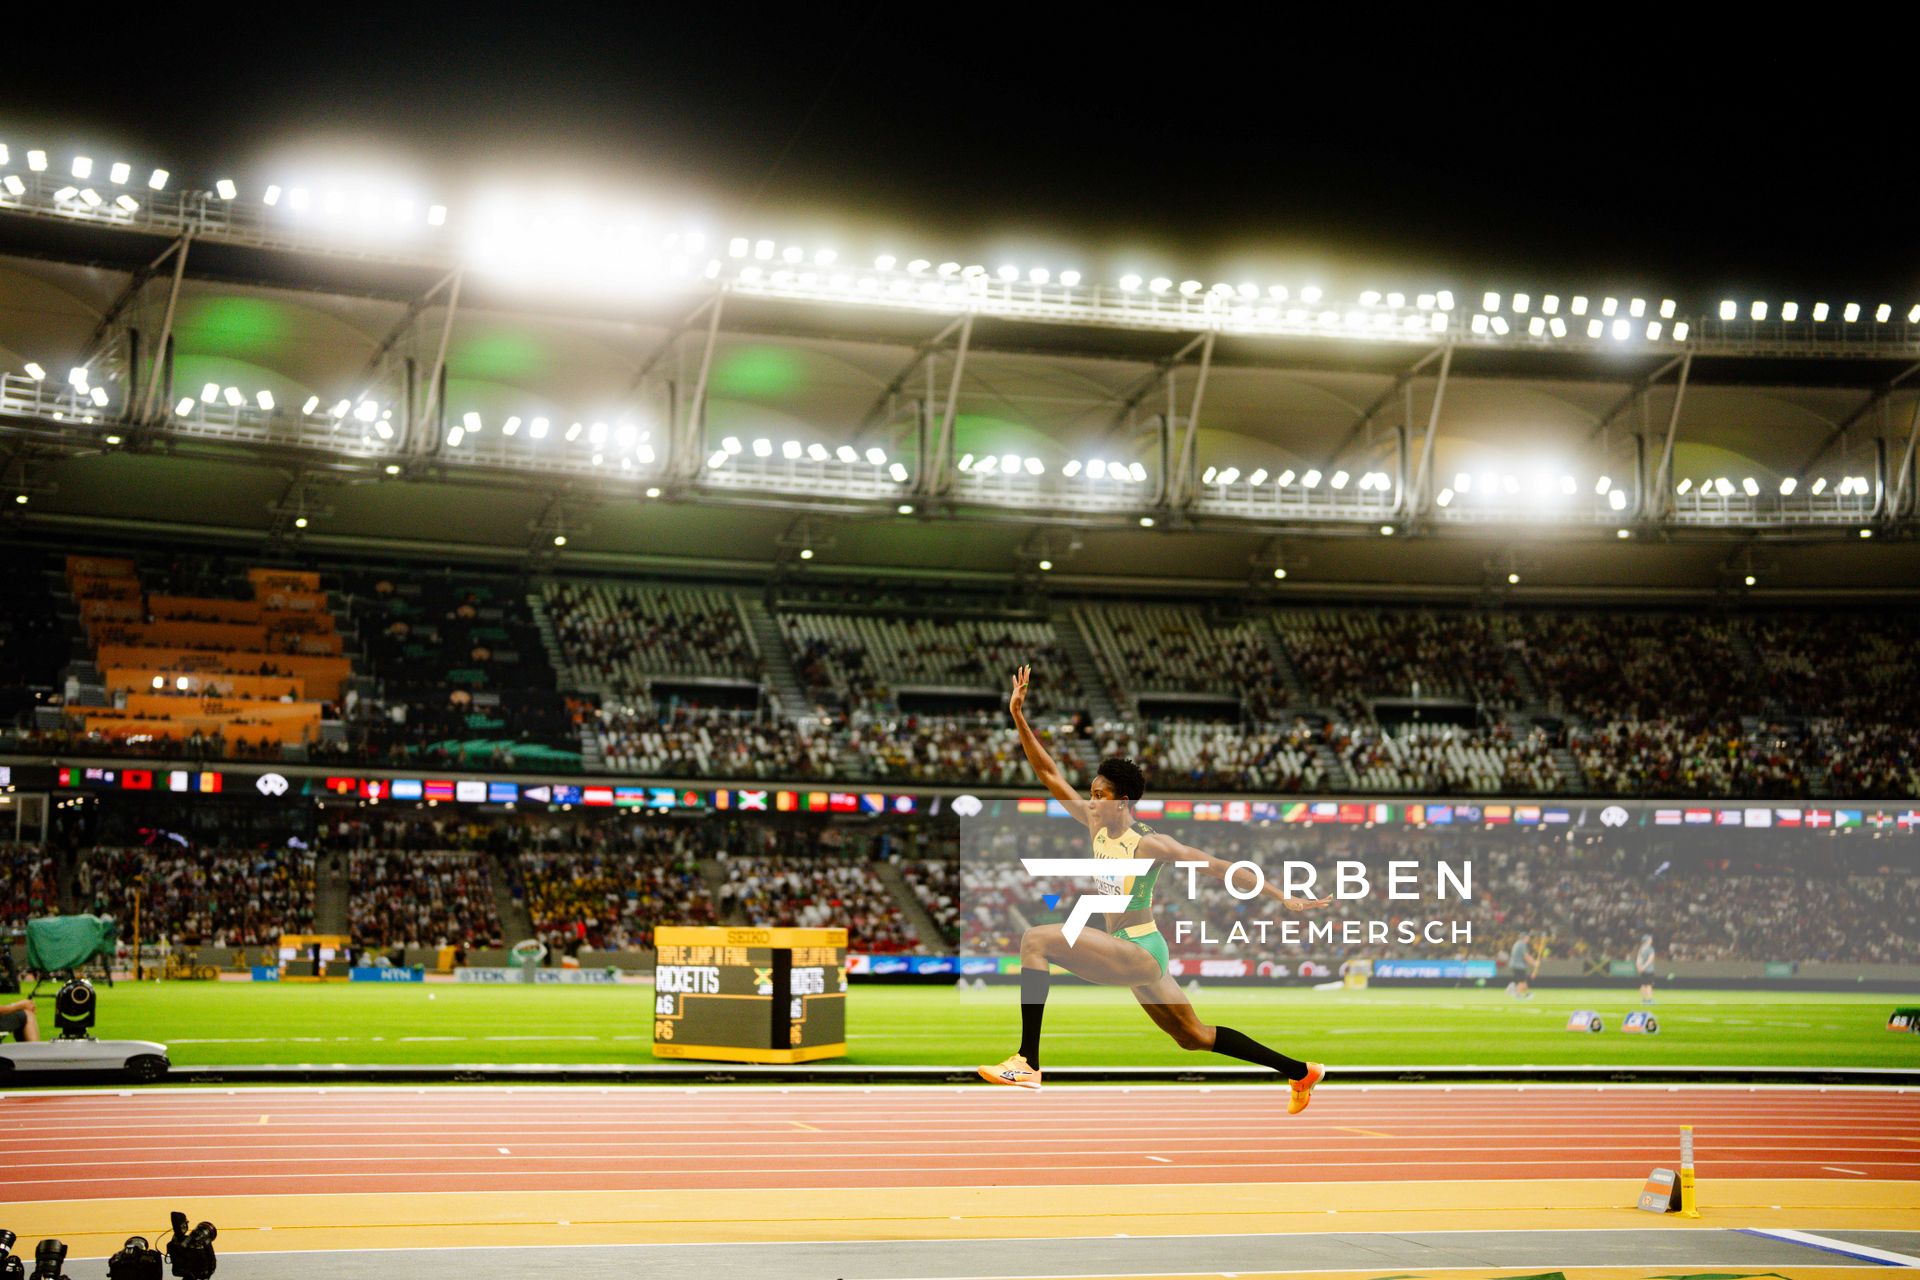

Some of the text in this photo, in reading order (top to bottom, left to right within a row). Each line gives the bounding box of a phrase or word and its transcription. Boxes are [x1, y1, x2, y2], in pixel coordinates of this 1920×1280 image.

[727, 931, 770, 944] SEIKO
[381, 968, 411, 980] NTN
[473, 970, 505, 982] TDK
